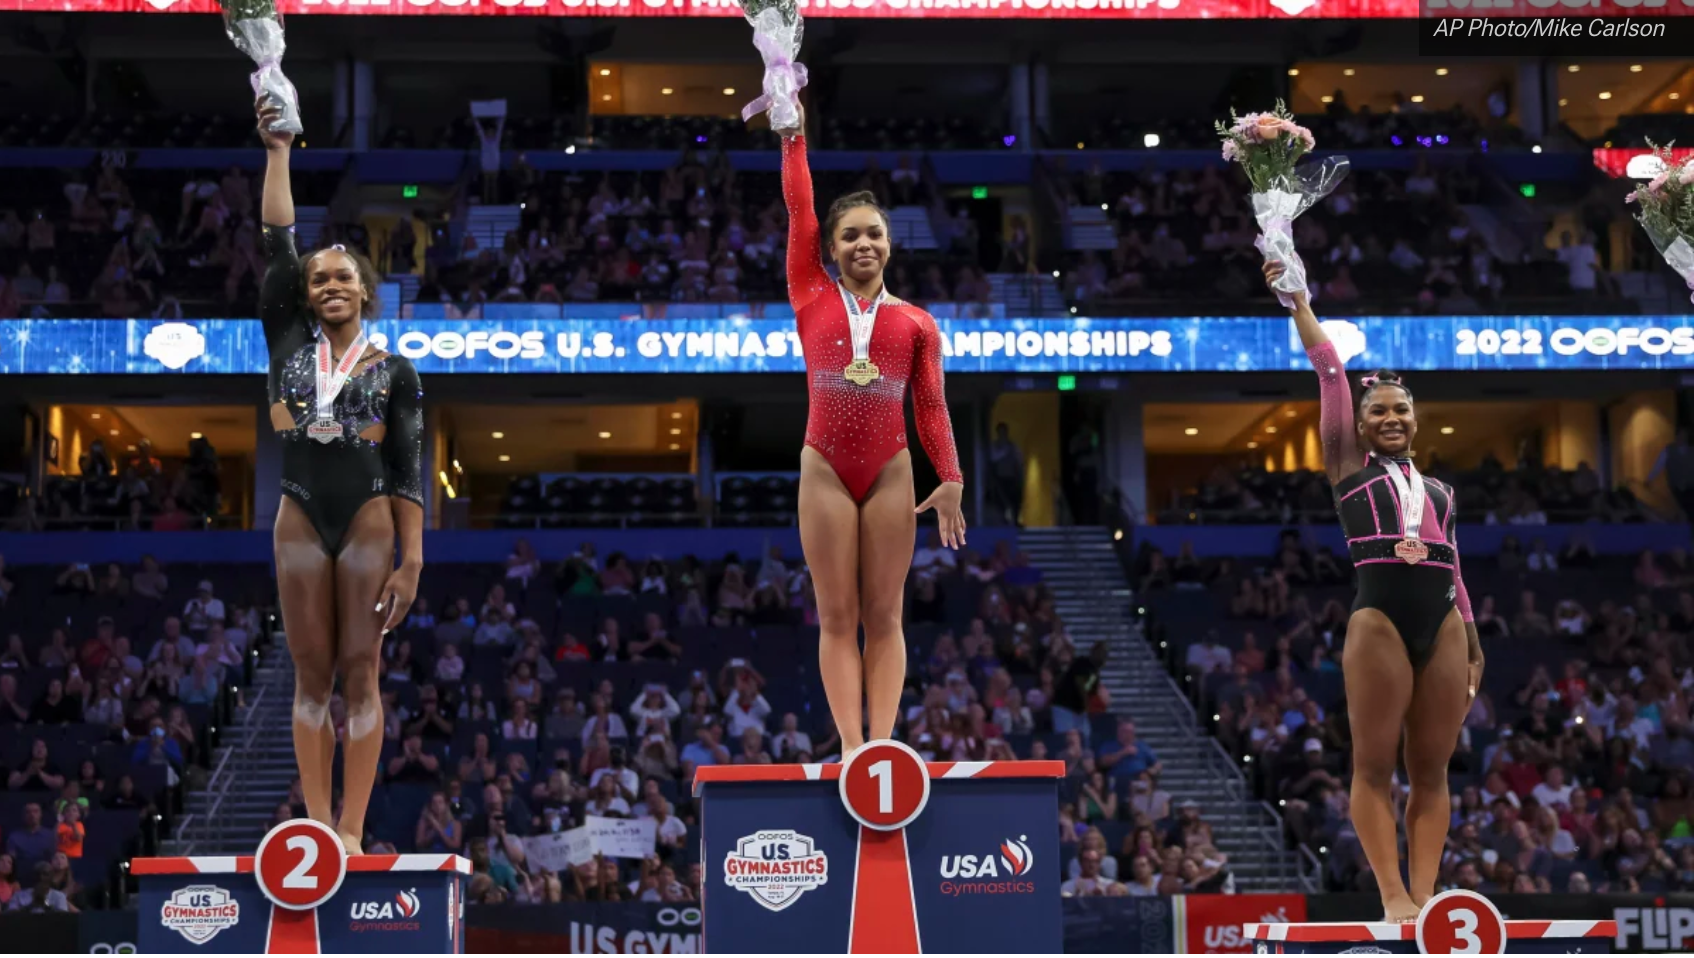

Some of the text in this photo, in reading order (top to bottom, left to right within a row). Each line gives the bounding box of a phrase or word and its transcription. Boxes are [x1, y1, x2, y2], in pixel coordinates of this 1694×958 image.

[397, 331, 544, 359] OOFOS
[556, 331, 626, 358] U.S.
[637, 331, 803, 358] GYMNAST
[940, 330, 1173, 358] AMPIONSHIPS
[1456, 327, 1694, 356] 2022 OOFOS
[868, 760, 893, 813] 1
[757, 833, 795, 841] OOFOS
[282, 835, 319, 889] 2
[727, 857, 825, 876] GYMNASTICS
[940, 855, 998, 878] USA
[736, 876, 817, 884] CHAMPIONSHIPS
[940, 881, 1035, 897] Gymnastics
[164, 904, 237, 918] GYMNASTICS
[350, 902, 394, 919] USA
[350, 921, 420, 932] Gymnastics
[1447, 908, 1482, 954] 3
[624, 929, 702, 954] GYM
